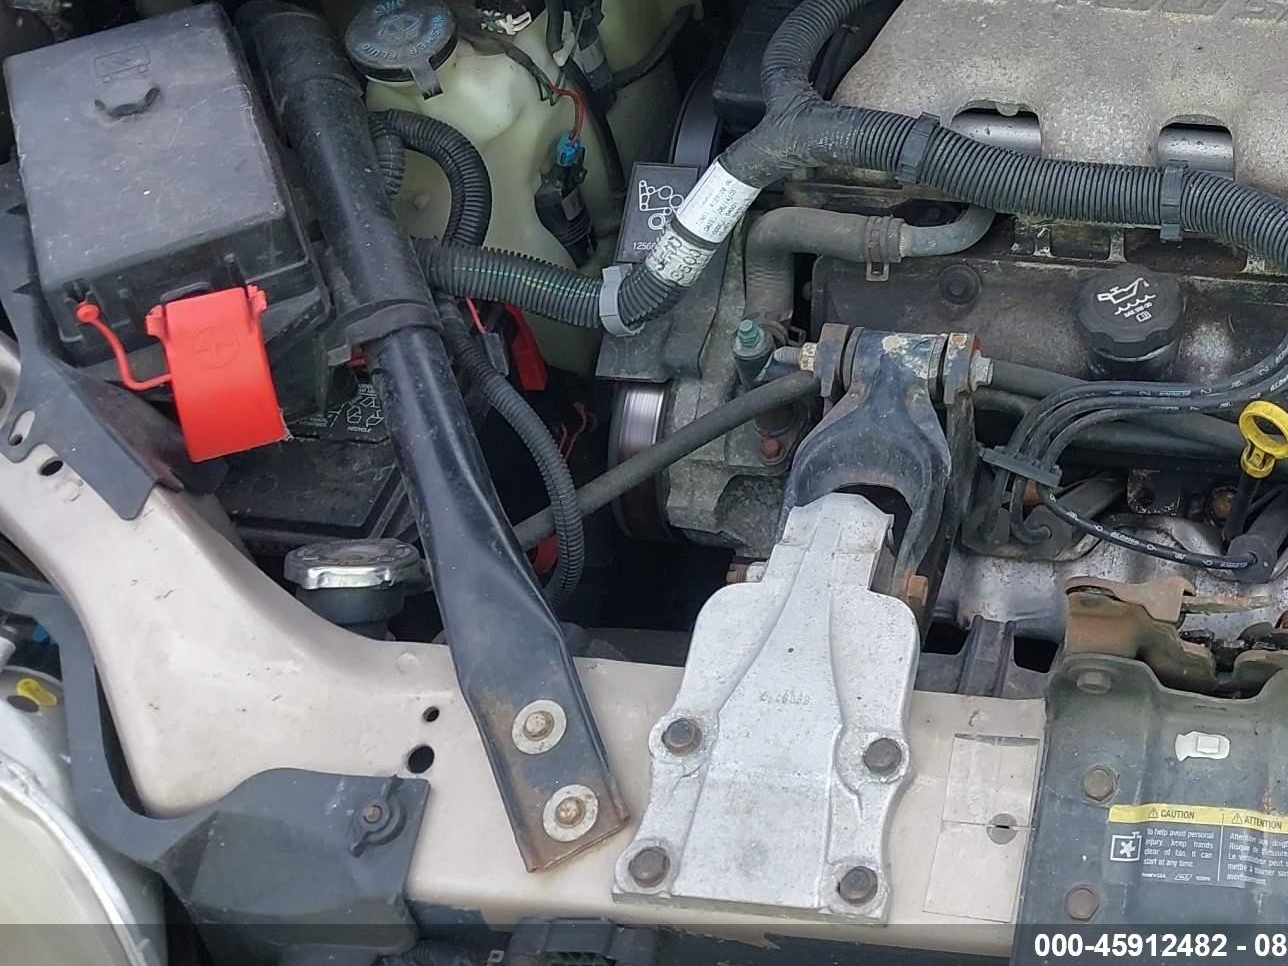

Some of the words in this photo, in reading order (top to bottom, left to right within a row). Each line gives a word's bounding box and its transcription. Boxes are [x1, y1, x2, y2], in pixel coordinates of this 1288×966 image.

[361, 42, 398, 59] FLUID
[1160, 809, 1195, 820] CAUTION
[1244, 815, 1282, 830] ATTENTION
[1154, 828, 1168, 837] help
[1187, 831, 1214, 839] personal
[1170, 839, 1187, 848] keep
[1193, 841, 1214, 849] hands
[1228, 842, 1251, 852] Risque
[1163, 848, 1171, 856] of
[1228, 852, 1237, 860] Le
[1158, 858, 1165, 866] at
[1165, 859, 1178, 868] any
